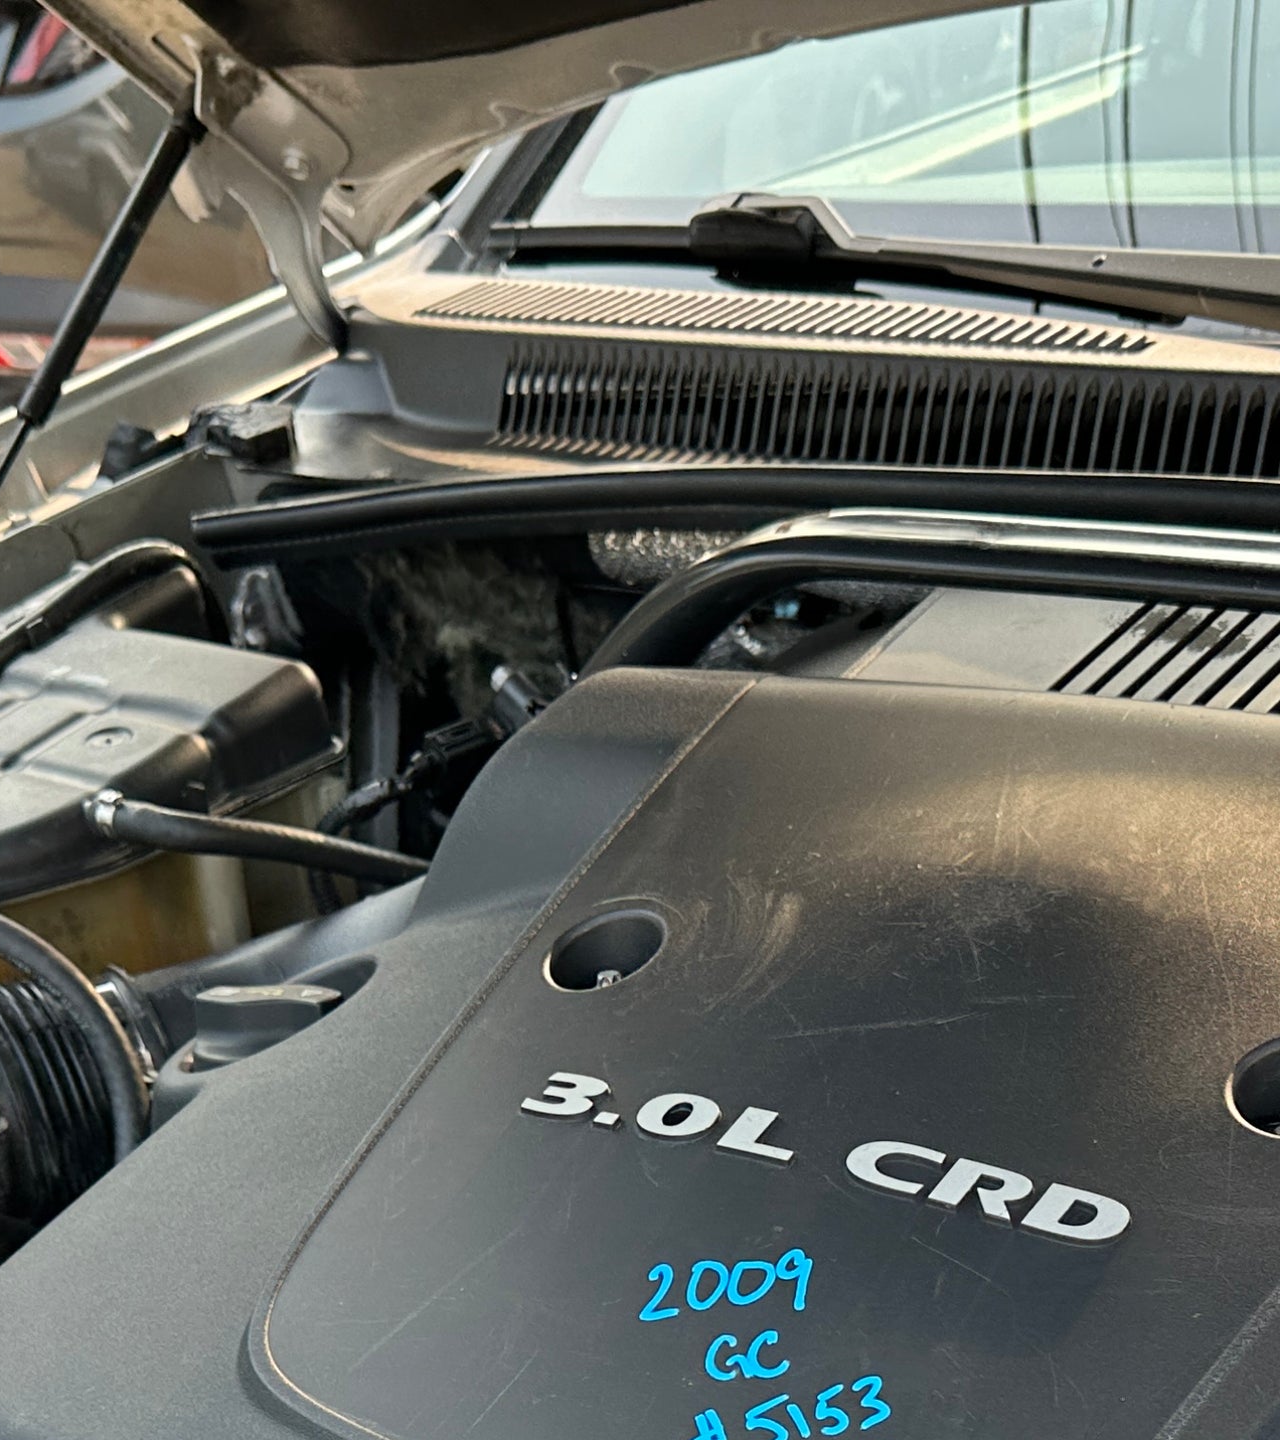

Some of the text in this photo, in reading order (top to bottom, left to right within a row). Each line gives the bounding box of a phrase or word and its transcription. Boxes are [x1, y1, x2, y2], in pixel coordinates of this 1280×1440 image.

[521, 1070, 1131, 1242] 3.0L CRD
[638, 1247, 813, 1321] 2009
[704, 1330, 791, 1381] GC
